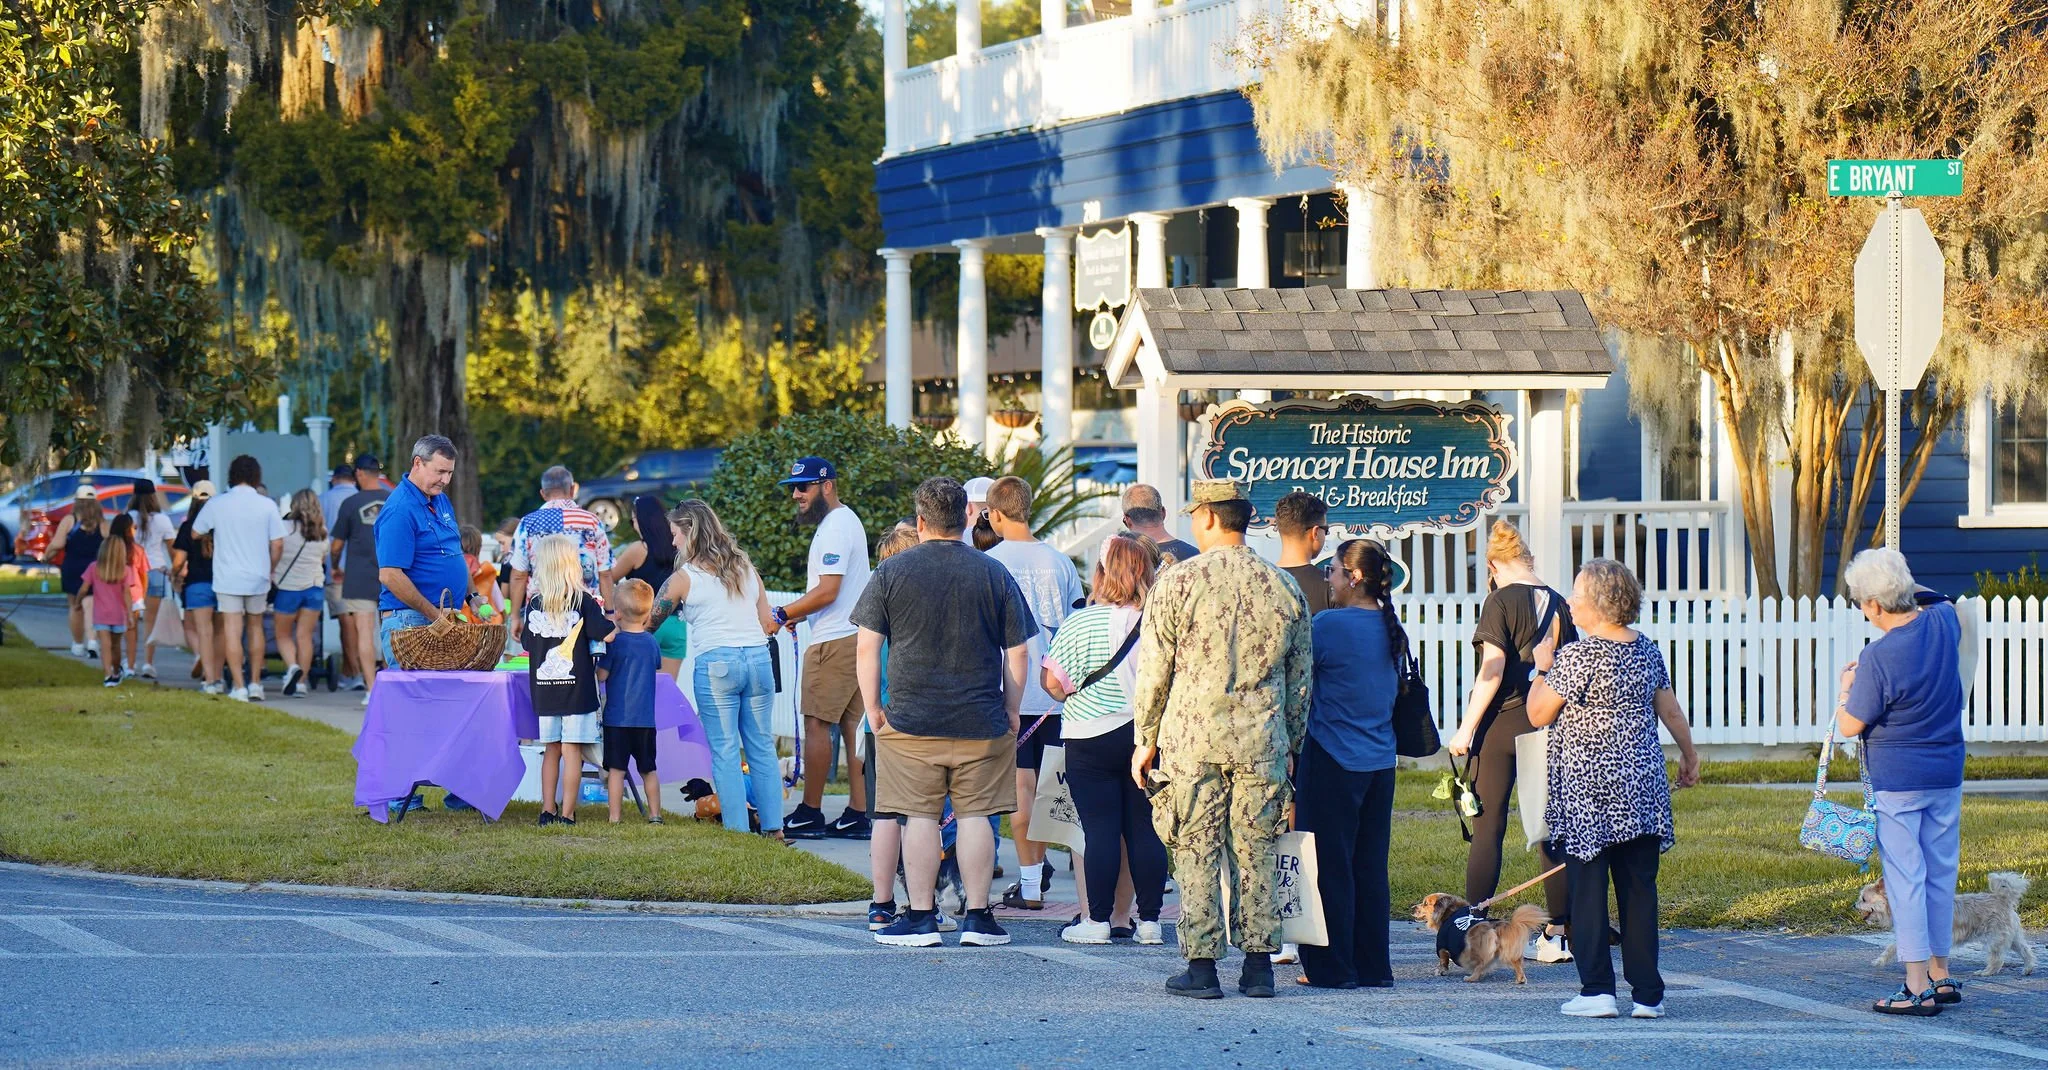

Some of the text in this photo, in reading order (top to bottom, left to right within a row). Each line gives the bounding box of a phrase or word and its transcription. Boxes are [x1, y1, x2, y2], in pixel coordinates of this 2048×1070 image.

[1829, 161, 1961, 192] E BRYANT ST
[1309, 422, 1412, 445] The Historic
[1226, 445, 1490, 492] Spencer House Inn
[1326, 486, 1346, 507] &
[1346, 484, 1429, 514] Breakfast
